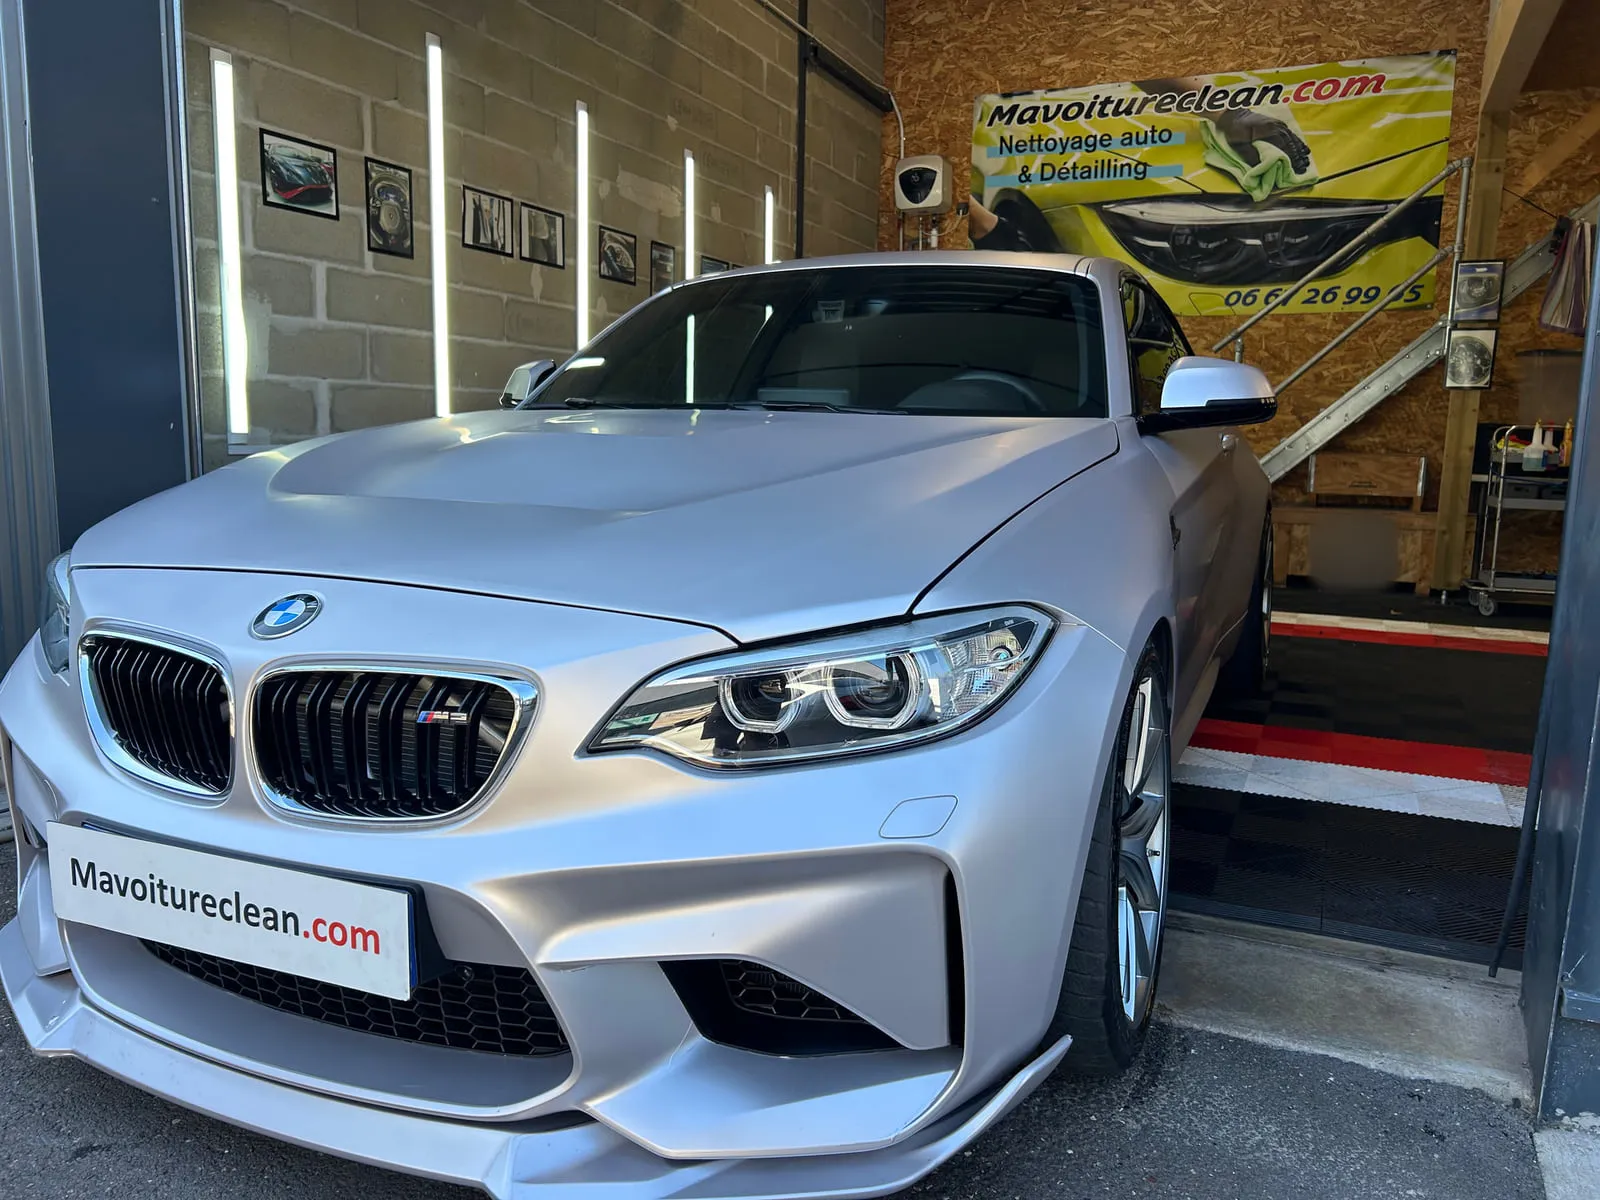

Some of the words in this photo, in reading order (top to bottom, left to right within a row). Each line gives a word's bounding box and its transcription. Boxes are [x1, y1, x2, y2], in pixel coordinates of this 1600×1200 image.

[986, 73, 1386, 127] Mavoitureclean.com
[999, 132, 1112, 155] Nettoyage
[1120, 125, 1173, 146] auto
[1018, 164, 1032, 183] &
[1040, 159, 1148, 181] Détailling
[1224, 288, 1259, 307] 06
[1301, 286, 1341, 304] 26
[1342, 285, 1380, 305] 99
[69, 856, 381, 955] Mavoitureclean.com
